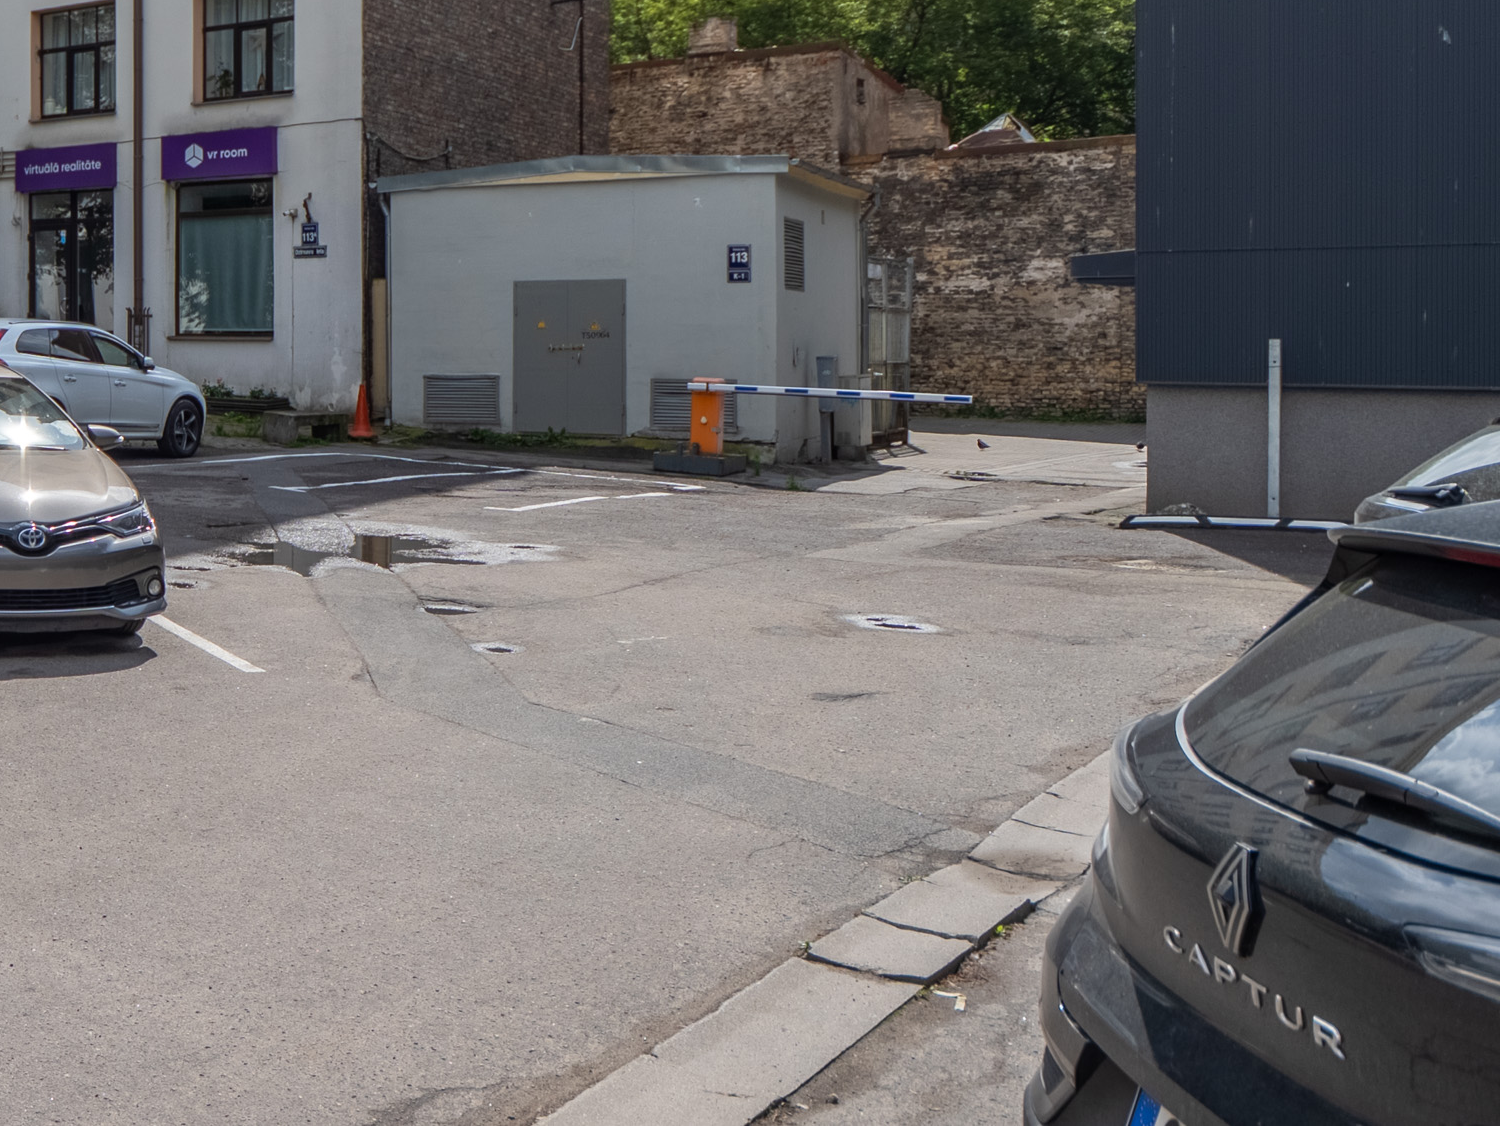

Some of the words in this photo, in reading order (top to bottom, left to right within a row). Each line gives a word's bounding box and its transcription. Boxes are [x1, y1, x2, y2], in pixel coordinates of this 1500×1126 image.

[207, 150, 217, 160] vr
[219, 147, 248, 158] room
[24, 160, 59, 176] virtuālā
[61, 158, 102, 173] realitāte
[730, 251, 748, 263] 113
[1163, 925, 1347, 1061] CAPTUR
